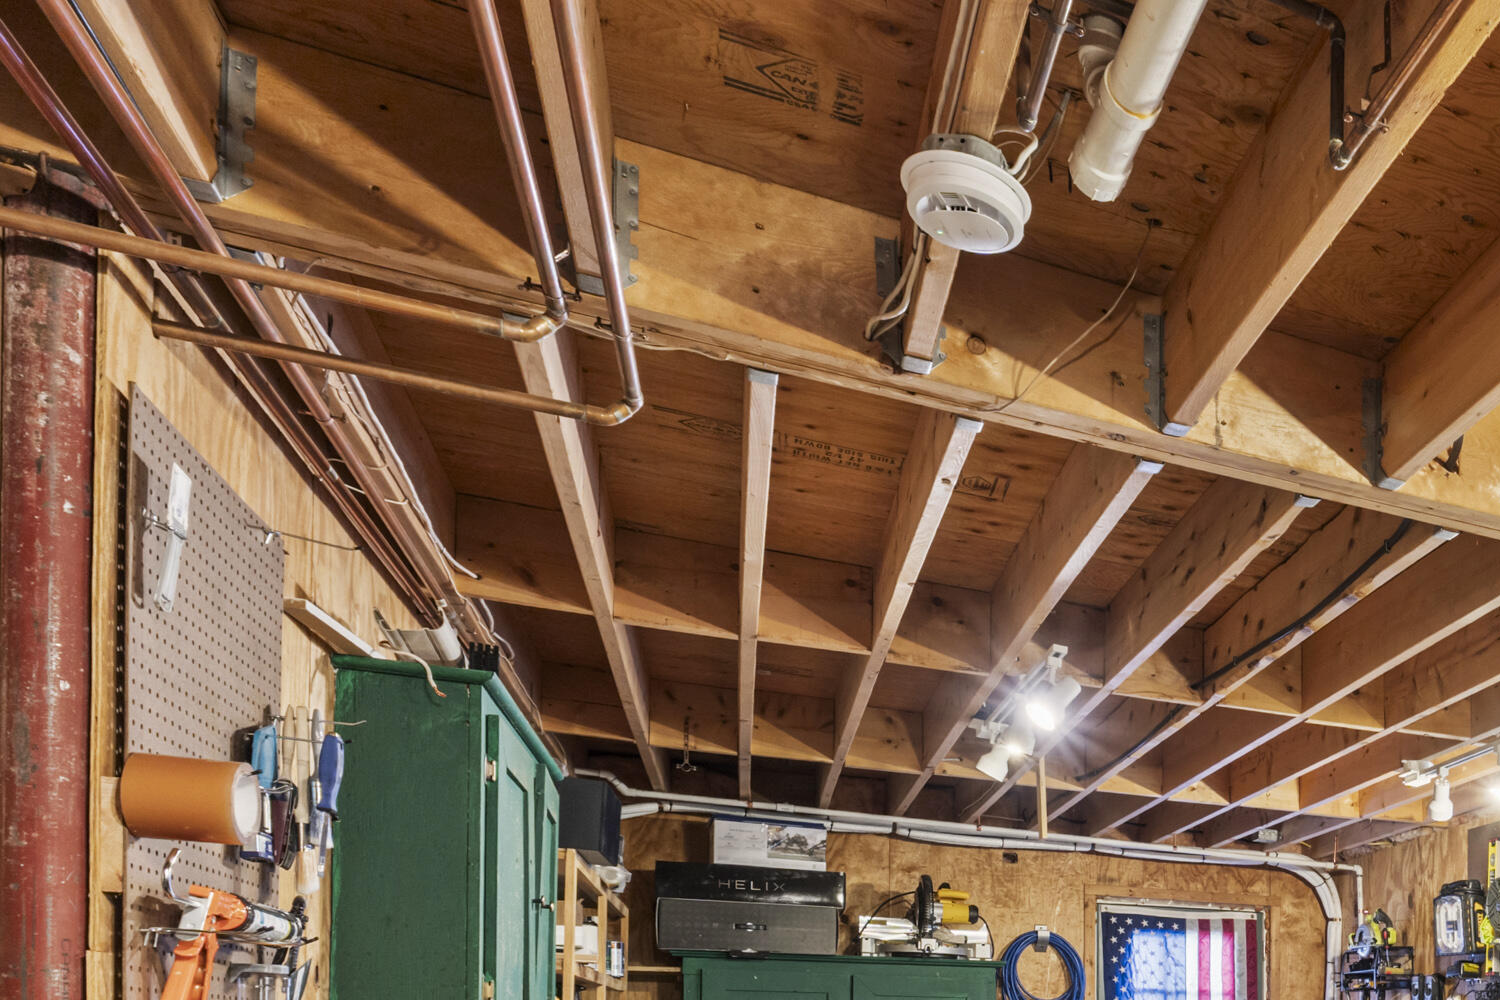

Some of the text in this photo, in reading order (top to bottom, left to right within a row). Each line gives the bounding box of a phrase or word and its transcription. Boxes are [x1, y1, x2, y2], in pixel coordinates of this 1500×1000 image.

[836, 447, 864, 457] SIDE
[869, 453, 897, 465] THIS
[717, 879, 785, 892] HELIX
